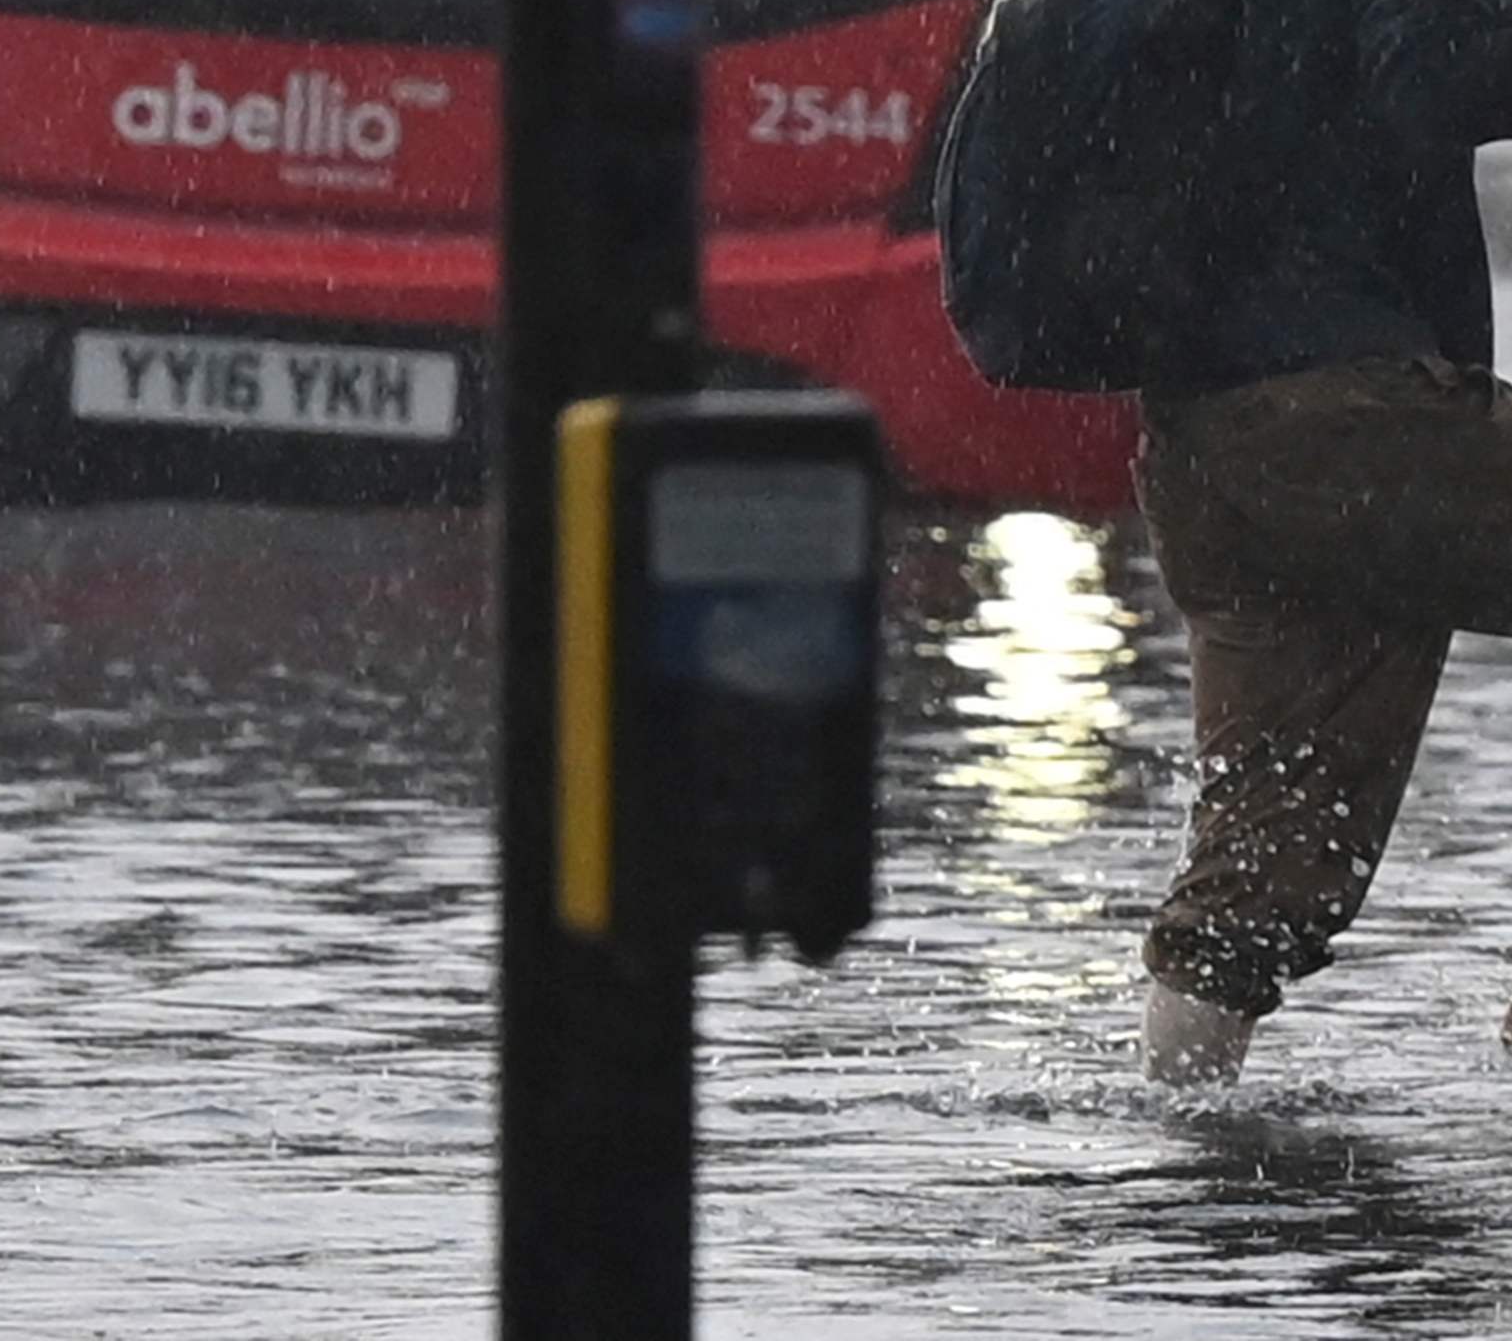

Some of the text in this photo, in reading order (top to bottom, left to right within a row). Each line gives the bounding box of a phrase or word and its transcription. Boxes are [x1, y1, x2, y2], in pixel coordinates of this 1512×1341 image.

[112, 59, 401, 161] abellio
[748, 81, 913, 148] 2544
[118, 343, 411, 421] YY16 YKH
